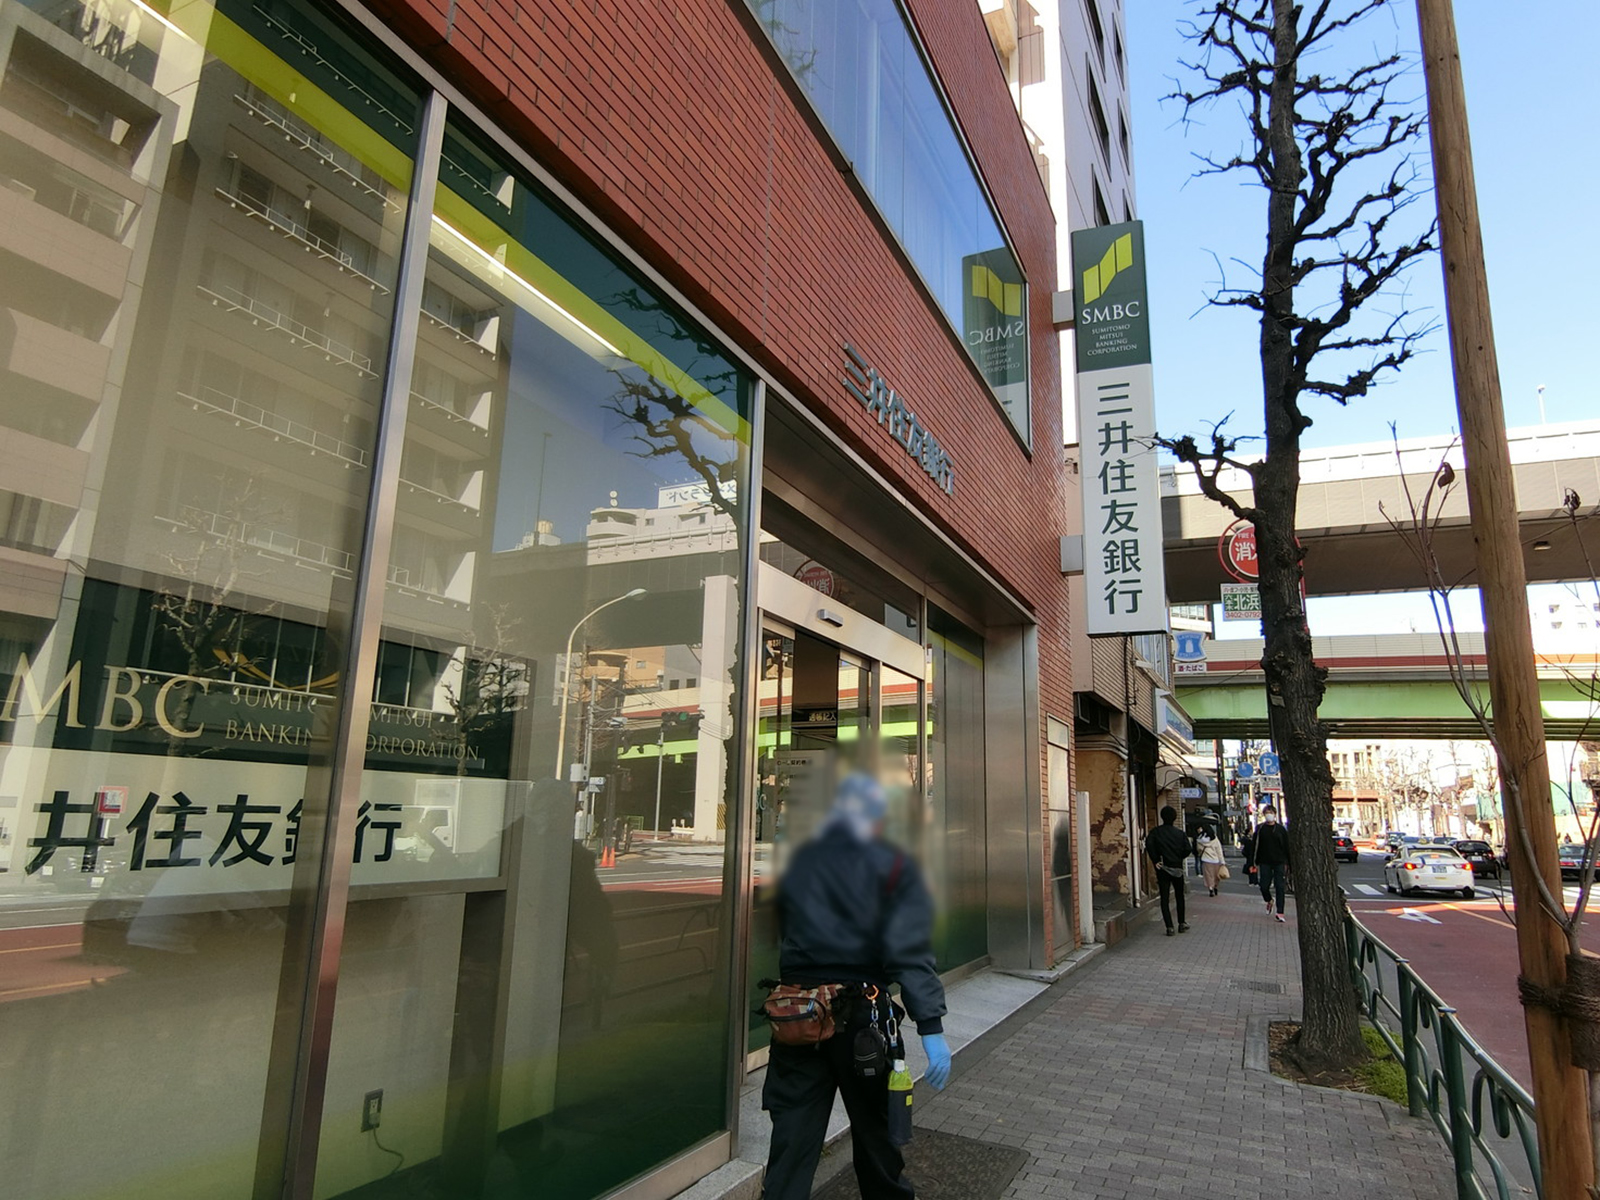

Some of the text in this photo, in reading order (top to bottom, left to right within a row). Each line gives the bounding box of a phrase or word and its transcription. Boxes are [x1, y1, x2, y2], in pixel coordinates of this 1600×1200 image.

[1081, 301, 1140, 325] SMBC
[1091, 323, 1131, 335] SUMITOMO
[1099, 331, 1124, 341] MITSUI
[1086, 343, 1138, 356] CORPORATION
[1095, 338, 1128, 348] BANKING
[842, 342, 955, 496] 三井住友銀行
[1097, 382, 1143, 615] 三井住友銀行
[365, 733, 480, 761] ORPORATION
[1263, 758, 1273, 773] P
